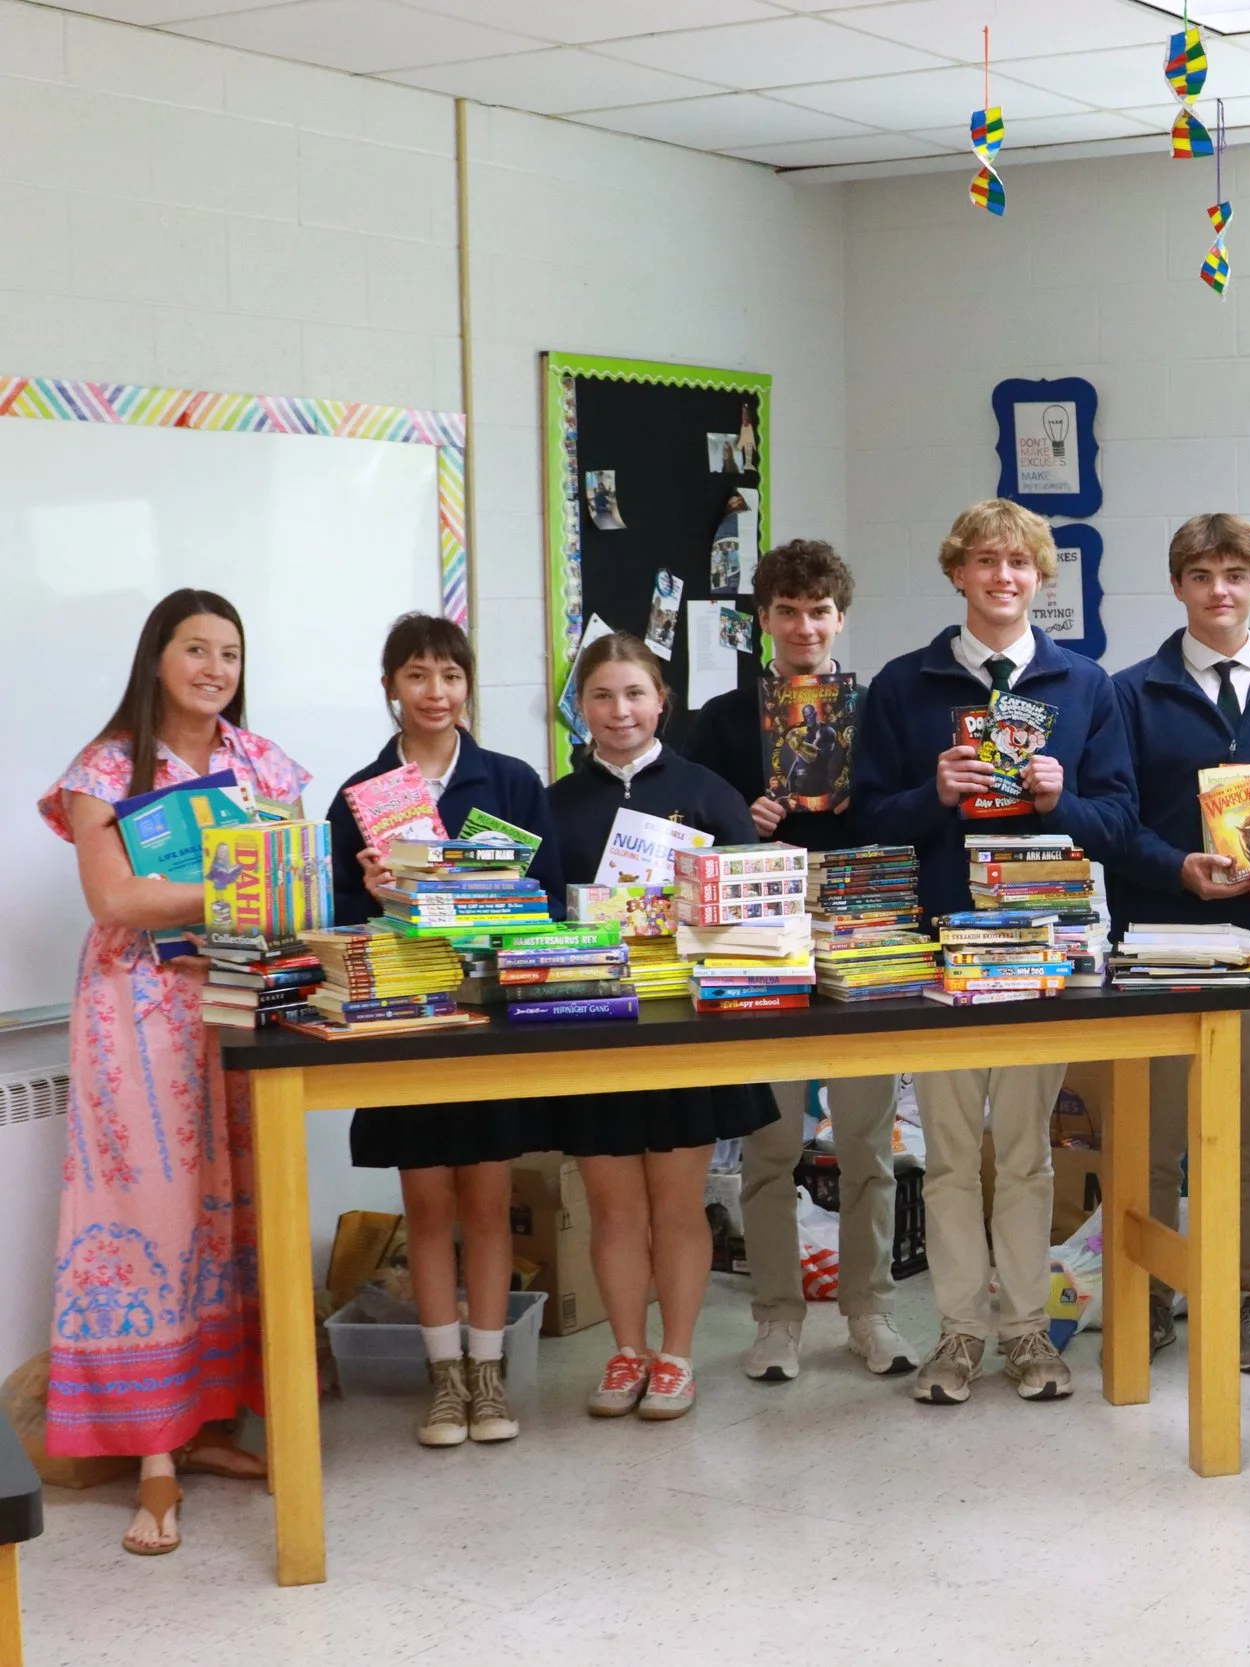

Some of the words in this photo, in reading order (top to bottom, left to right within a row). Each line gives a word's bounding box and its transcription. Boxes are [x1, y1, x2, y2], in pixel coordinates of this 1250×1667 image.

[1020, 447, 1050, 456] MAKE
[1032, 608, 1075, 618] TRYING!
[964, 716, 985, 733] DO
[613, 833, 675, 863] NUMBE
[1026, 851, 1041, 861] ARK
[1041, 851, 1063, 860] ANGEL
[513, 936, 579, 946] HAMSTERSAURUS
[582, 935, 598, 945] REX
